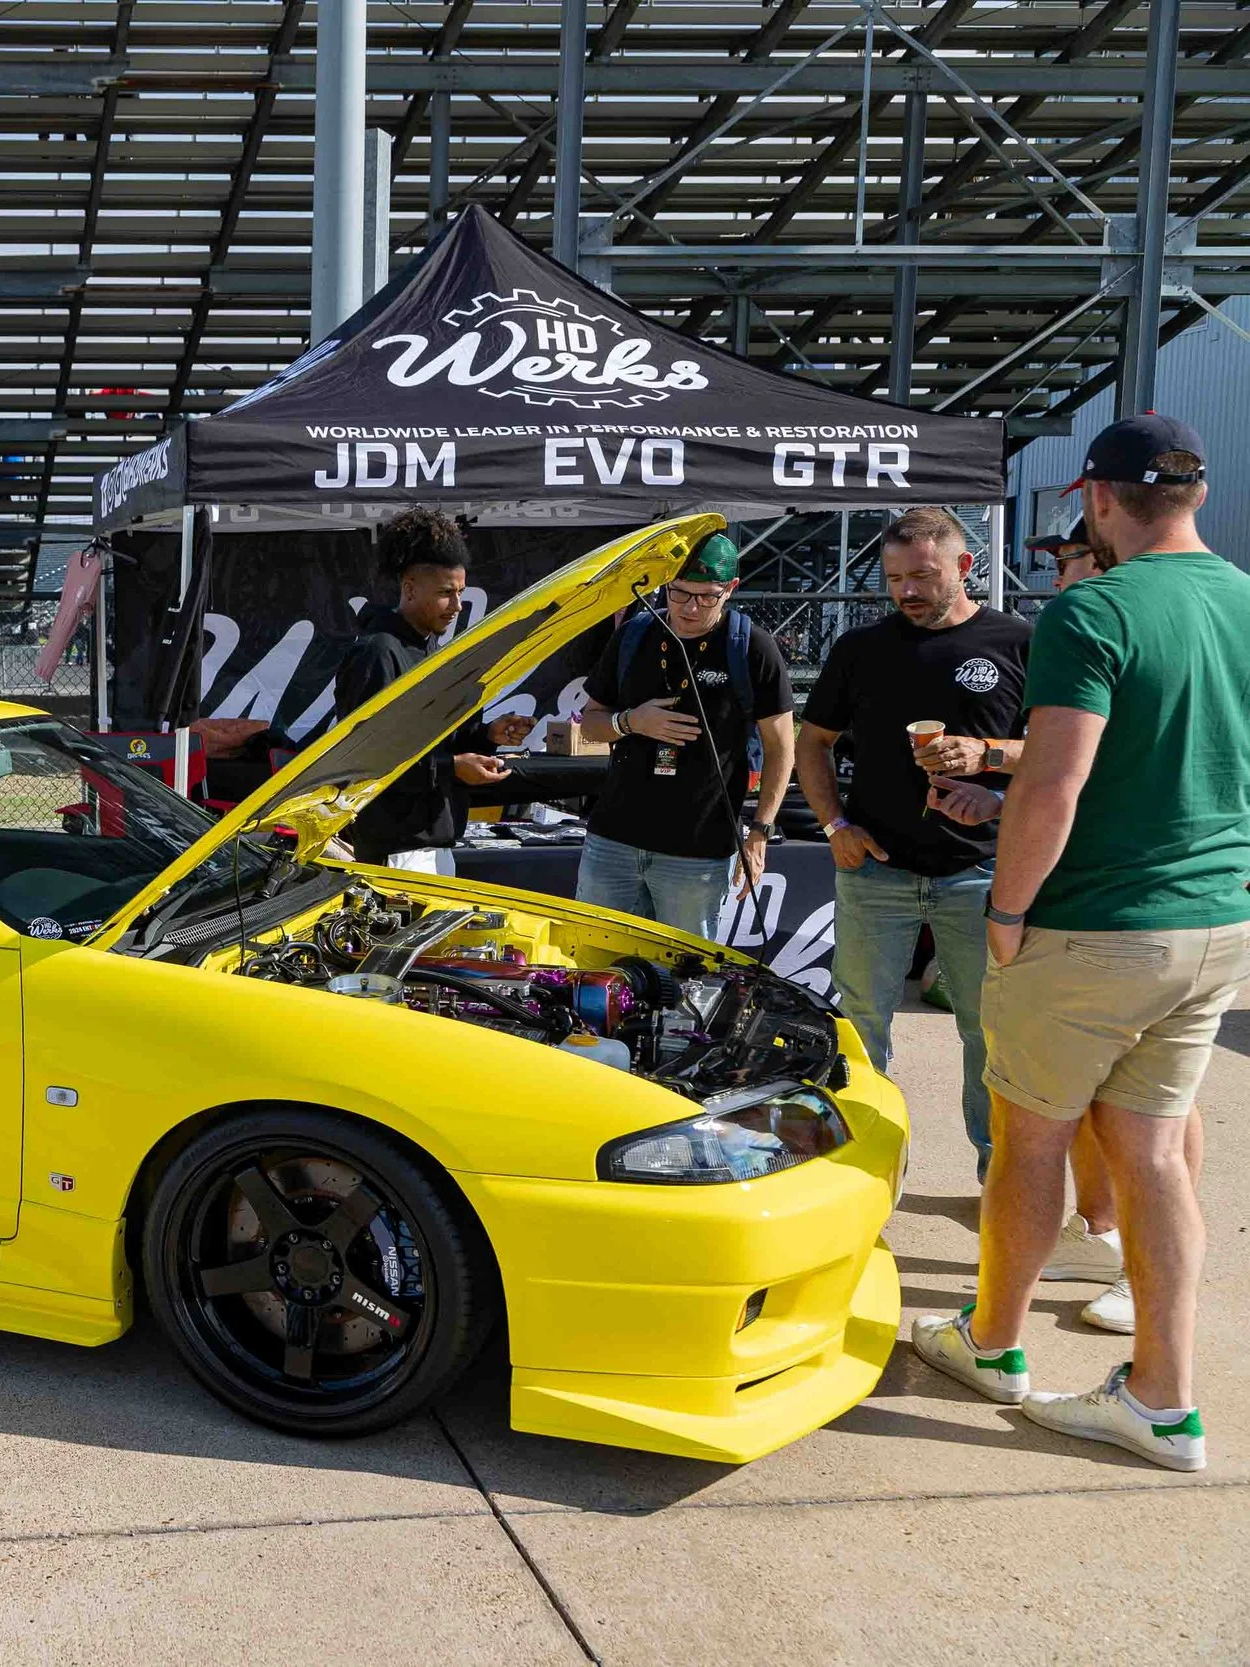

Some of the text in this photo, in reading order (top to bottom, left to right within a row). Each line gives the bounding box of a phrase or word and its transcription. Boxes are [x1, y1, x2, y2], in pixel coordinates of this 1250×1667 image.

[536, 318, 598, 354] HD
[371, 320, 710, 390] Werks
[305, 424, 919, 439] WORLDWIDE LEADER IN PERFORMANCE & RESTORATION
[314, 437, 912, 488] JDM EVO GTR
[955, 667, 999, 684] Werks
[27, 922, 63, 936] Werks
[51, 1176, 73, 1190] GT
[387, 1246, 400, 1297] NISSAN
